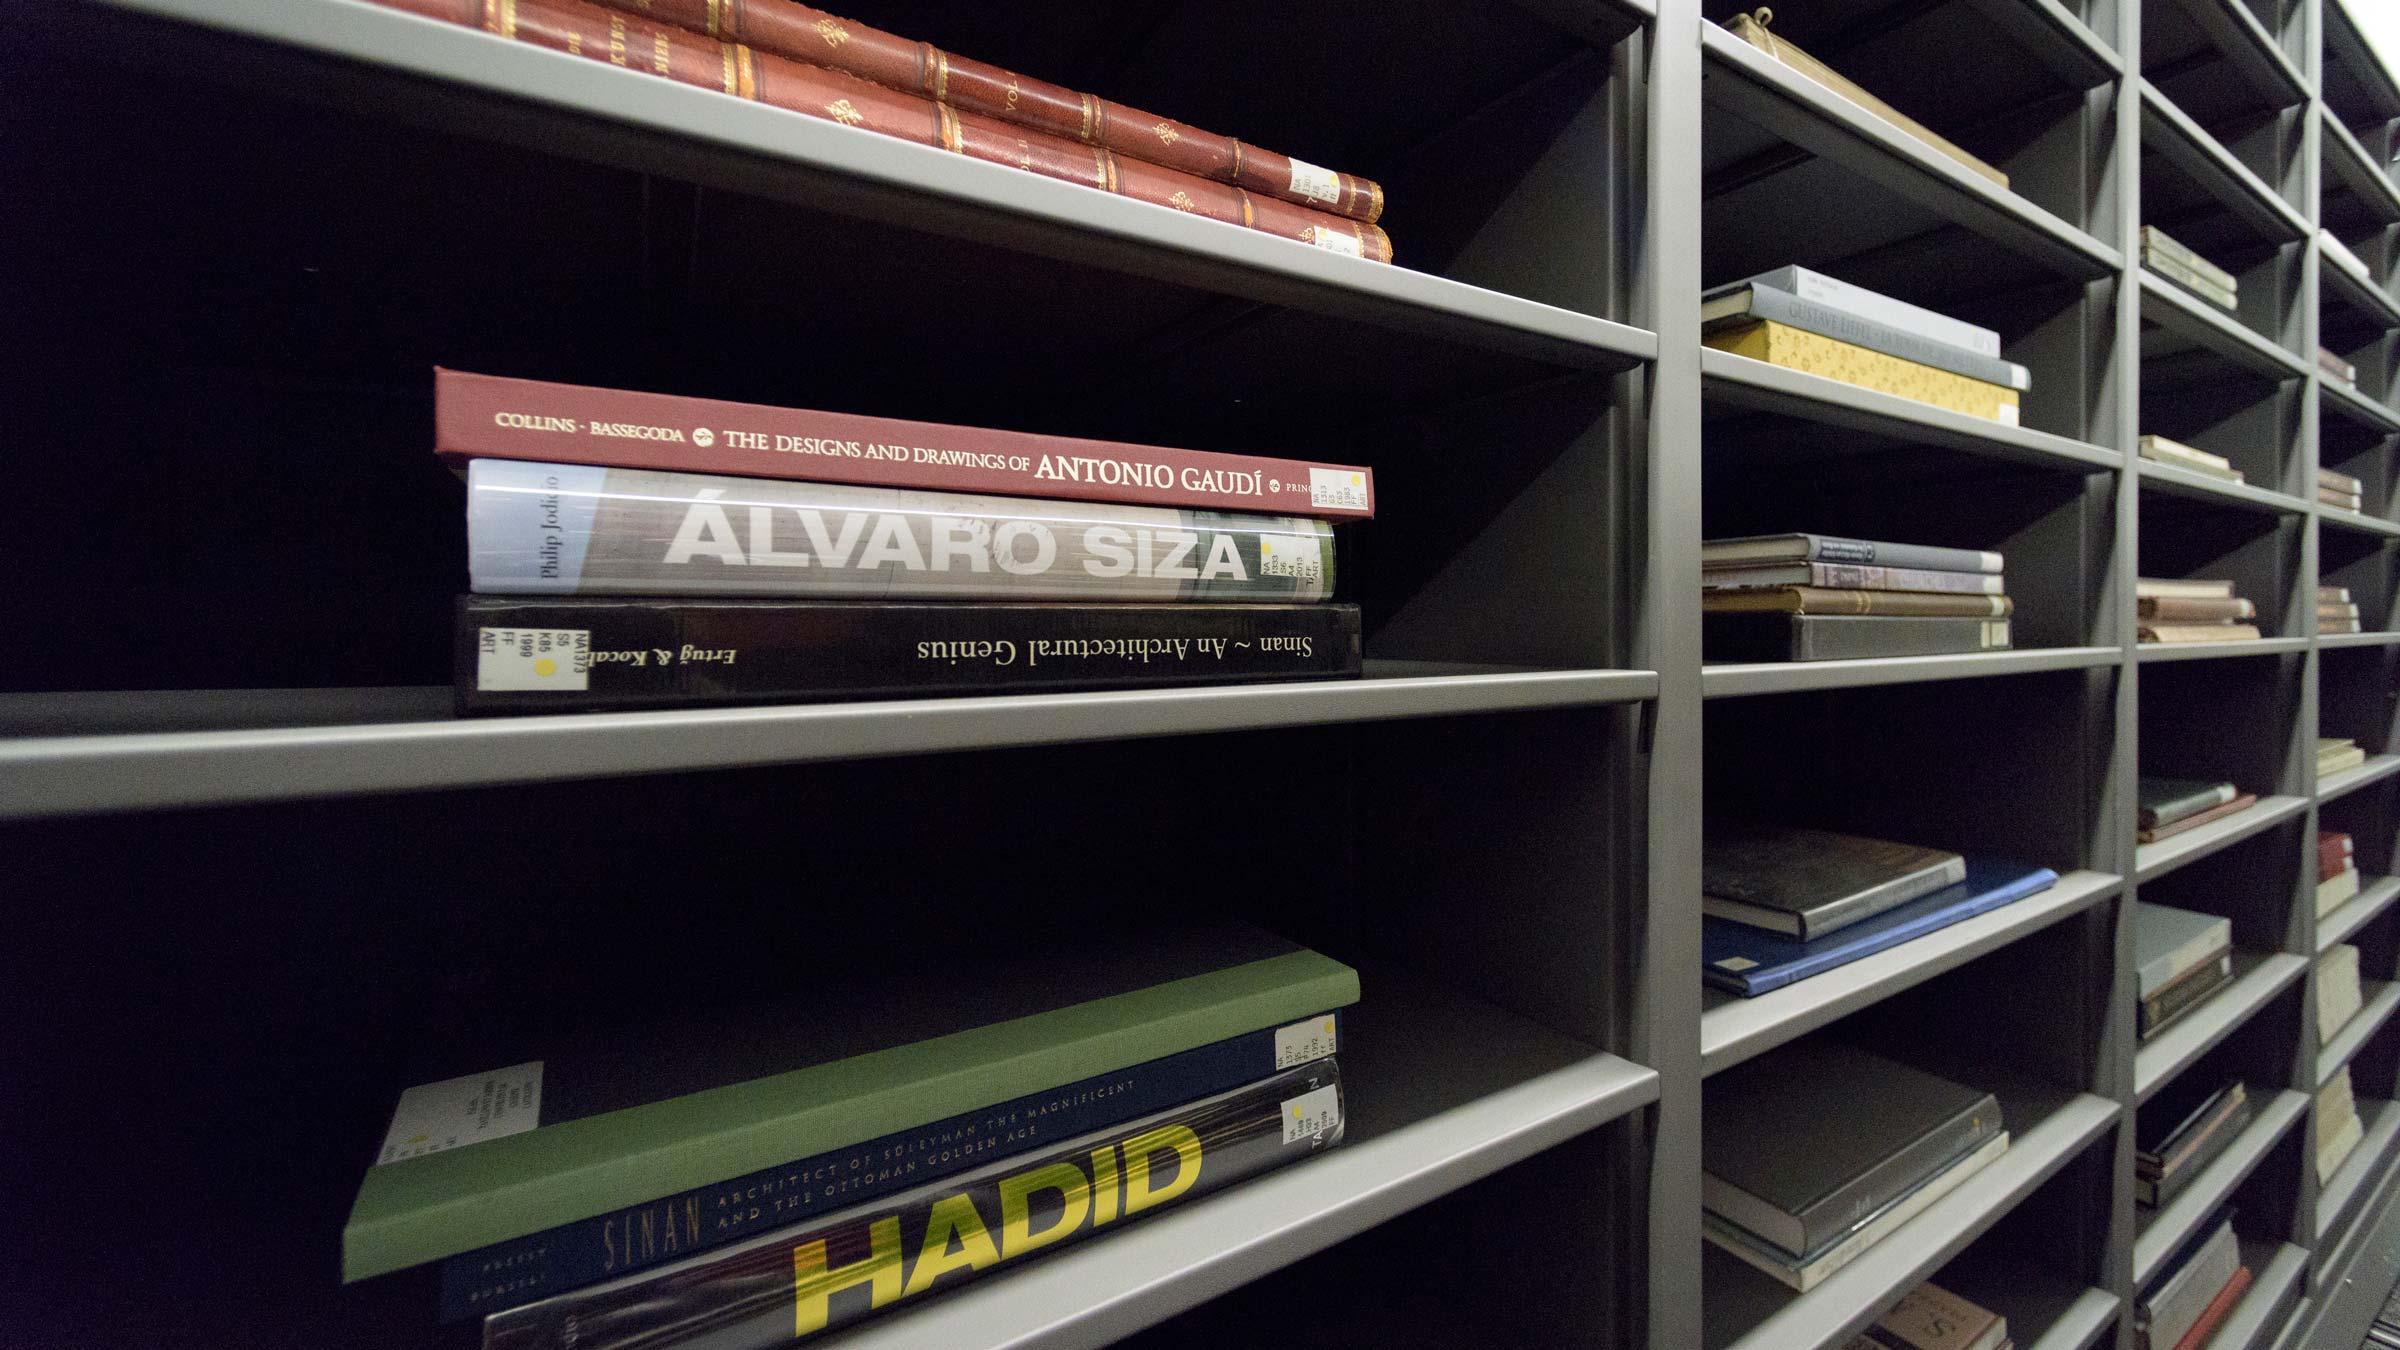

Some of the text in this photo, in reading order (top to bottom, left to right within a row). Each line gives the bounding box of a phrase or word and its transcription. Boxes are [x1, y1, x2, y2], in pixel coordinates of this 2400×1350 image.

[1006, 80, 1018, 112] VOL
[495, 411, 576, 433] COLLINS
[590, 421, 685, 442] BASSEGODA
[723, 431, 768, 450] THE
[775, 435, 861, 458] DESIGNS
[864, 443, 909, 461] AND
[913, 447, 1006, 470] DRAWINGS
[1008, 455, 1030, 471] OF
[1034, 454, 1174, 489] ANTONIO
[1181, 467, 1263, 495] GAUDÍ
[662, 488, 1248, 581] ÁLVARO SIZA
[540, 536, 563, 579] Philip
[1263, 562, 1270, 575] NA
[1280, 561, 1286, 574] S6
[1288, 565, 1294, 576] A4
[482, 631, 496, 654] ART
[501, 631, 515, 645] FF
[520, 633, 534, 657] 1999
[538, 632, 552, 652] K85
[557, 633, 570, 646] S5
[1198, 638, 1227, 659] An
[1260, 636, 1313, 658] Sinan
[573, 633, 587, 673] NA1373
[653, 648, 673, 666] &
[679, 644, 737, 665] Ertuğ
[917, 640, 1016, 666] Genius
[1030, 638, 1189, 665] Architectural
[603, 1195, 699, 1271] SINAN
[718, 1164, 837, 1208] ARCHITECT
[850, 1155, 873, 1170] OF
[987, 1113, 1017, 1130] THE
[1027, 1080, 1134, 1119] MAGNIFICENT
[718, 1125, 1037, 1229] AND THE OTTOMAN GOLDEN AGE
[793, 1123, 1202, 1338] HADID
